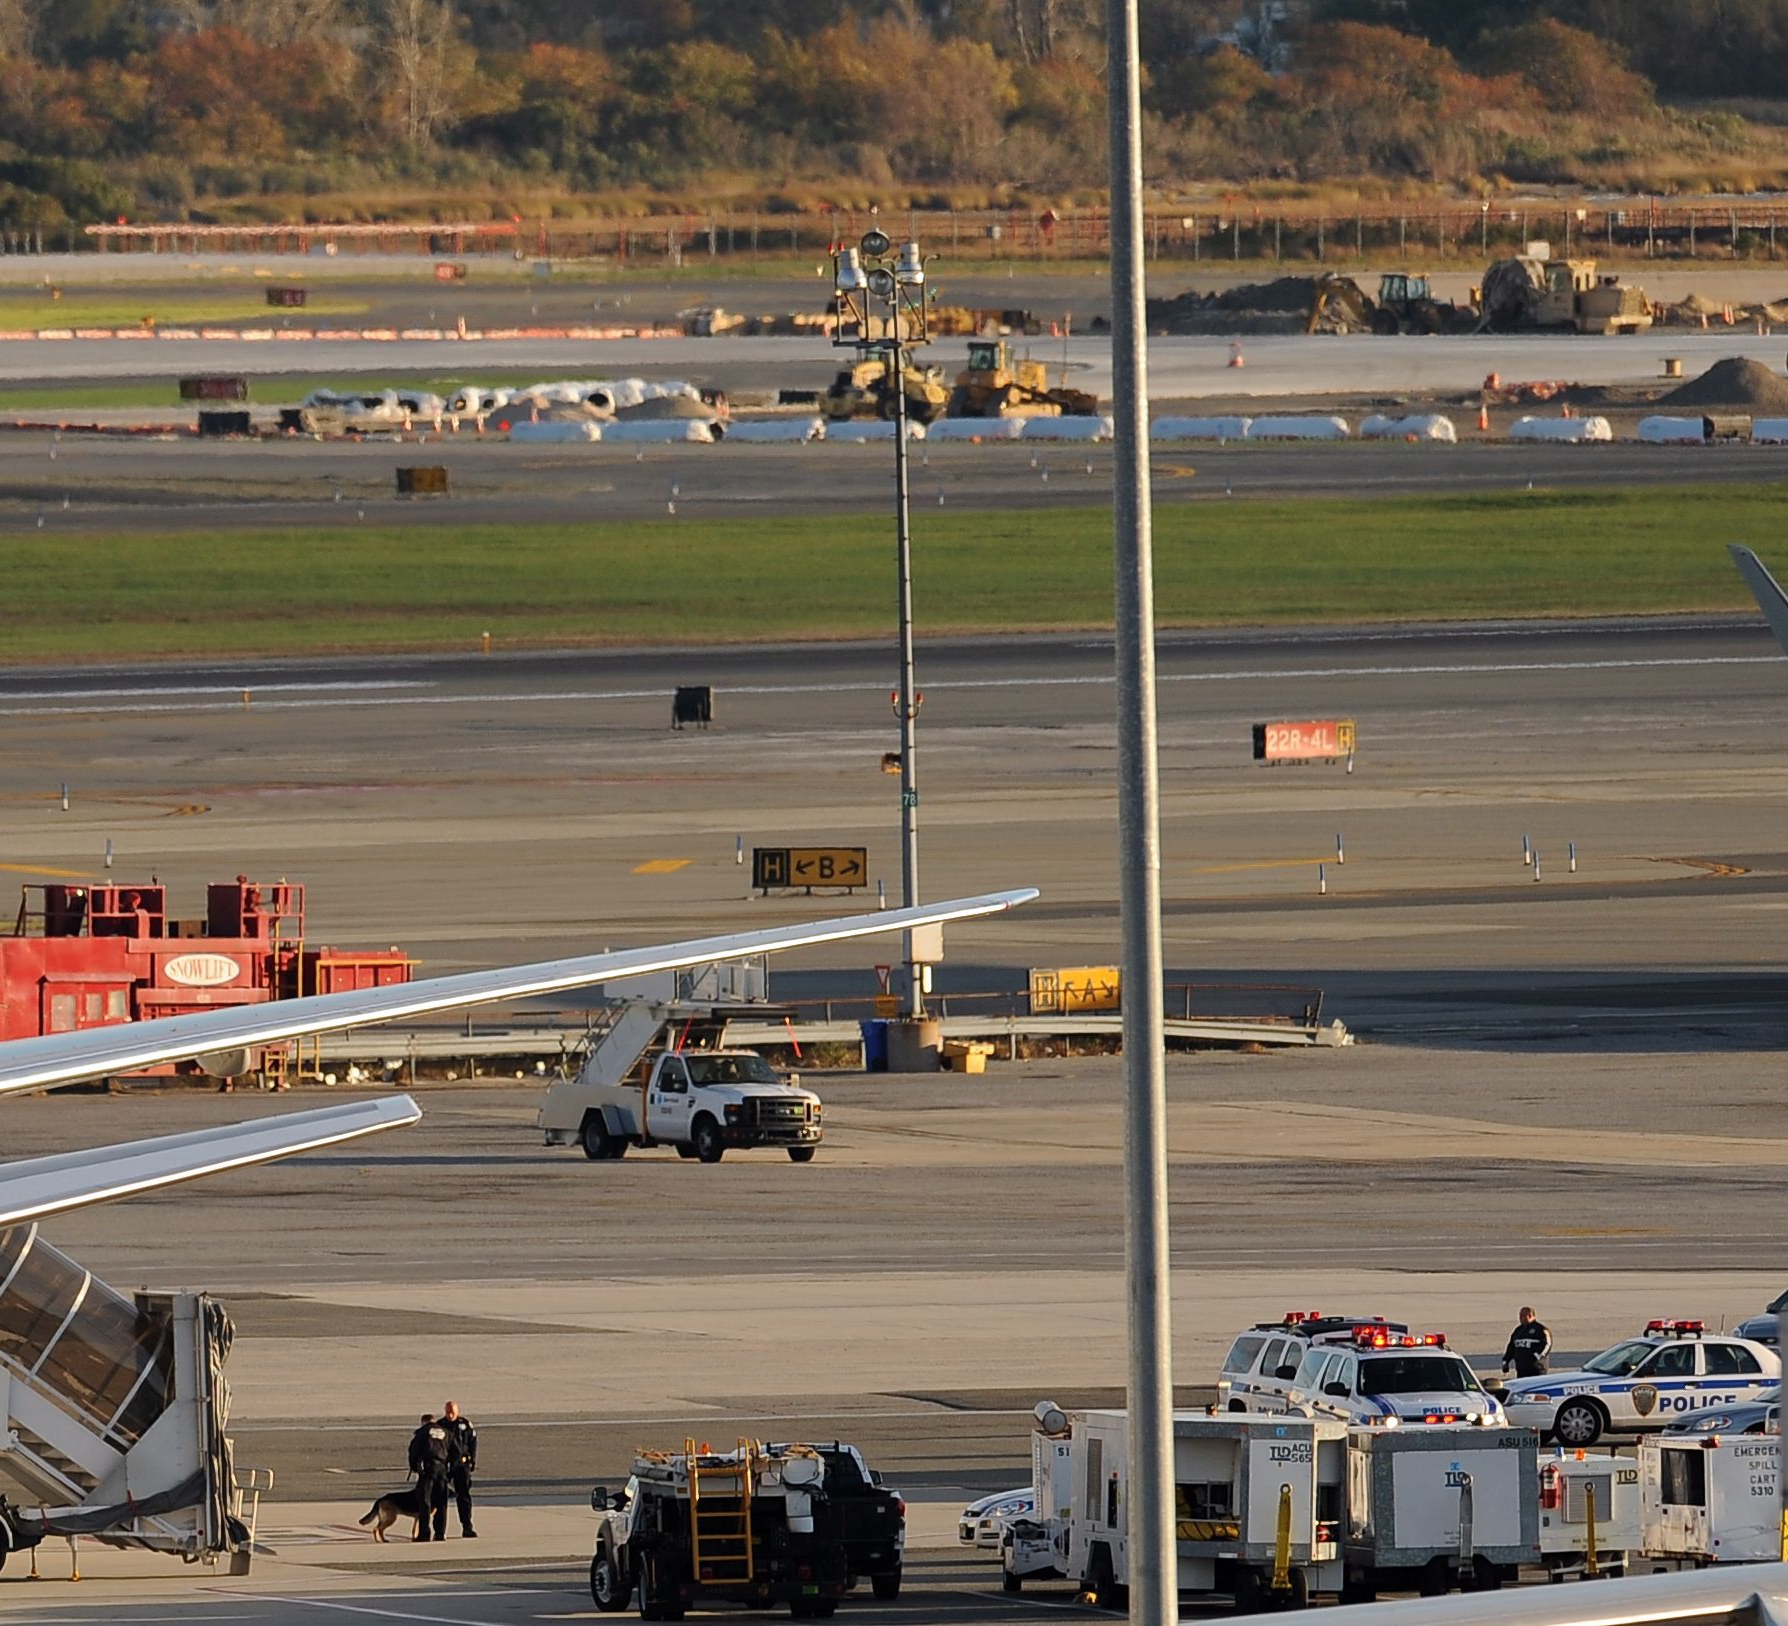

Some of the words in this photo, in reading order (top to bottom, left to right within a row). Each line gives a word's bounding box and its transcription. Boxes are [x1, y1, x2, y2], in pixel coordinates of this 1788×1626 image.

[1266, 728, 1333, 752] 22R-4L
[902, 793, 917, 806] 78
[764, 856, 780, 880] H
[819, 856, 835, 879] B
[171, 959, 233, 980] SNOWLIFT
[1081, 978, 1097, 1003] A
[1422, 1405, 1461, 1415] POLICE
[1292, 1443, 1312, 1453] ACU
[1498, 1436, 1521, 1449] ASU
[1269, 1445, 1291, 1459] TLD
[1748, 1460, 1778, 1471] SPILL
[1615, 1469, 1638, 1482] TLD
[1749, 1474, 1777, 1485] CART
[1750, 1486, 1774, 1496] 5310
